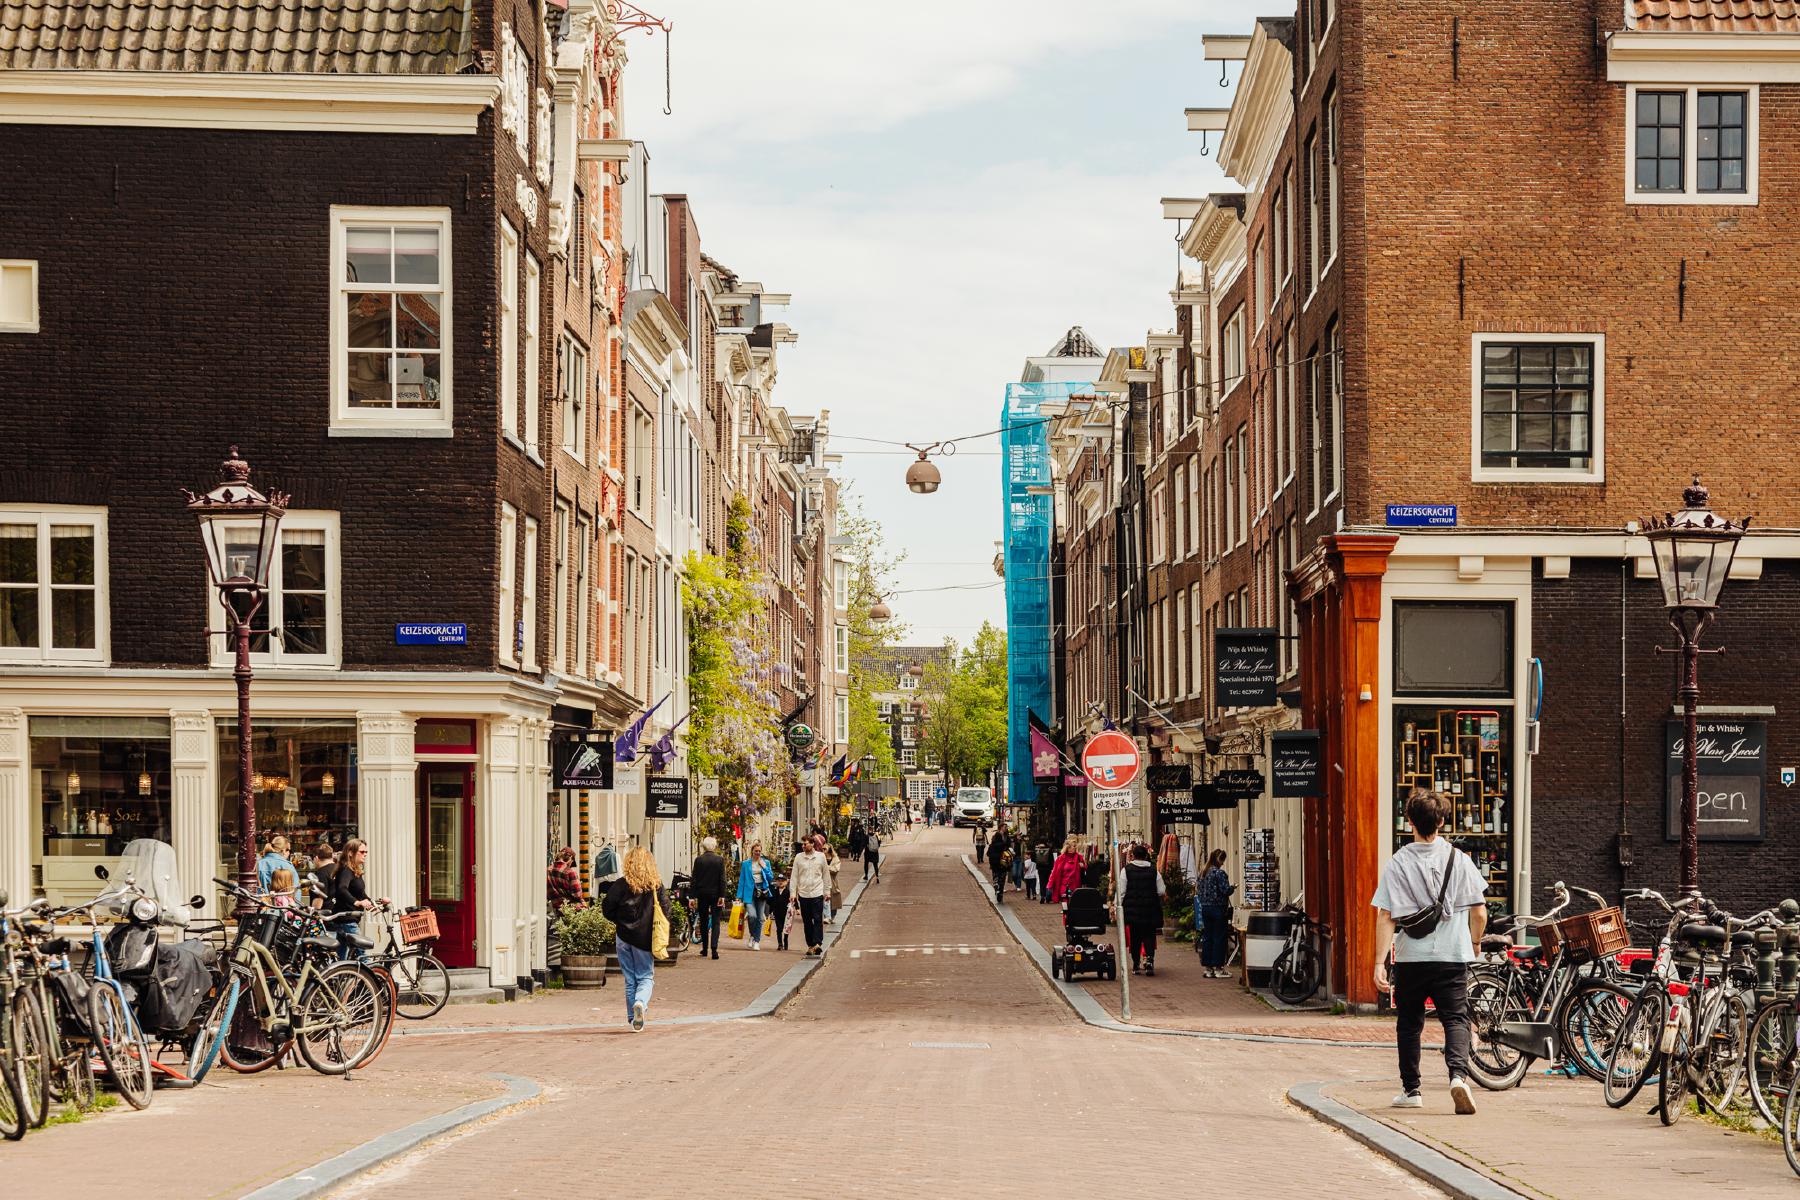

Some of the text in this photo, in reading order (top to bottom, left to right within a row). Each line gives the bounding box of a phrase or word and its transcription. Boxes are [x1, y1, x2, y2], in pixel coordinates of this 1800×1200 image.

[1390, 507, 1454, 516] KEIZERSGRACHT
[400, 626, 464, 635] KEIZERSGRACHT
[1247, 646, 1268, 654] Whisky
[1716, 725, 1744, 734] Whisky
[1722, 738, 1761, 762] Jacob
[1681, 791, 1748, 818] pen
